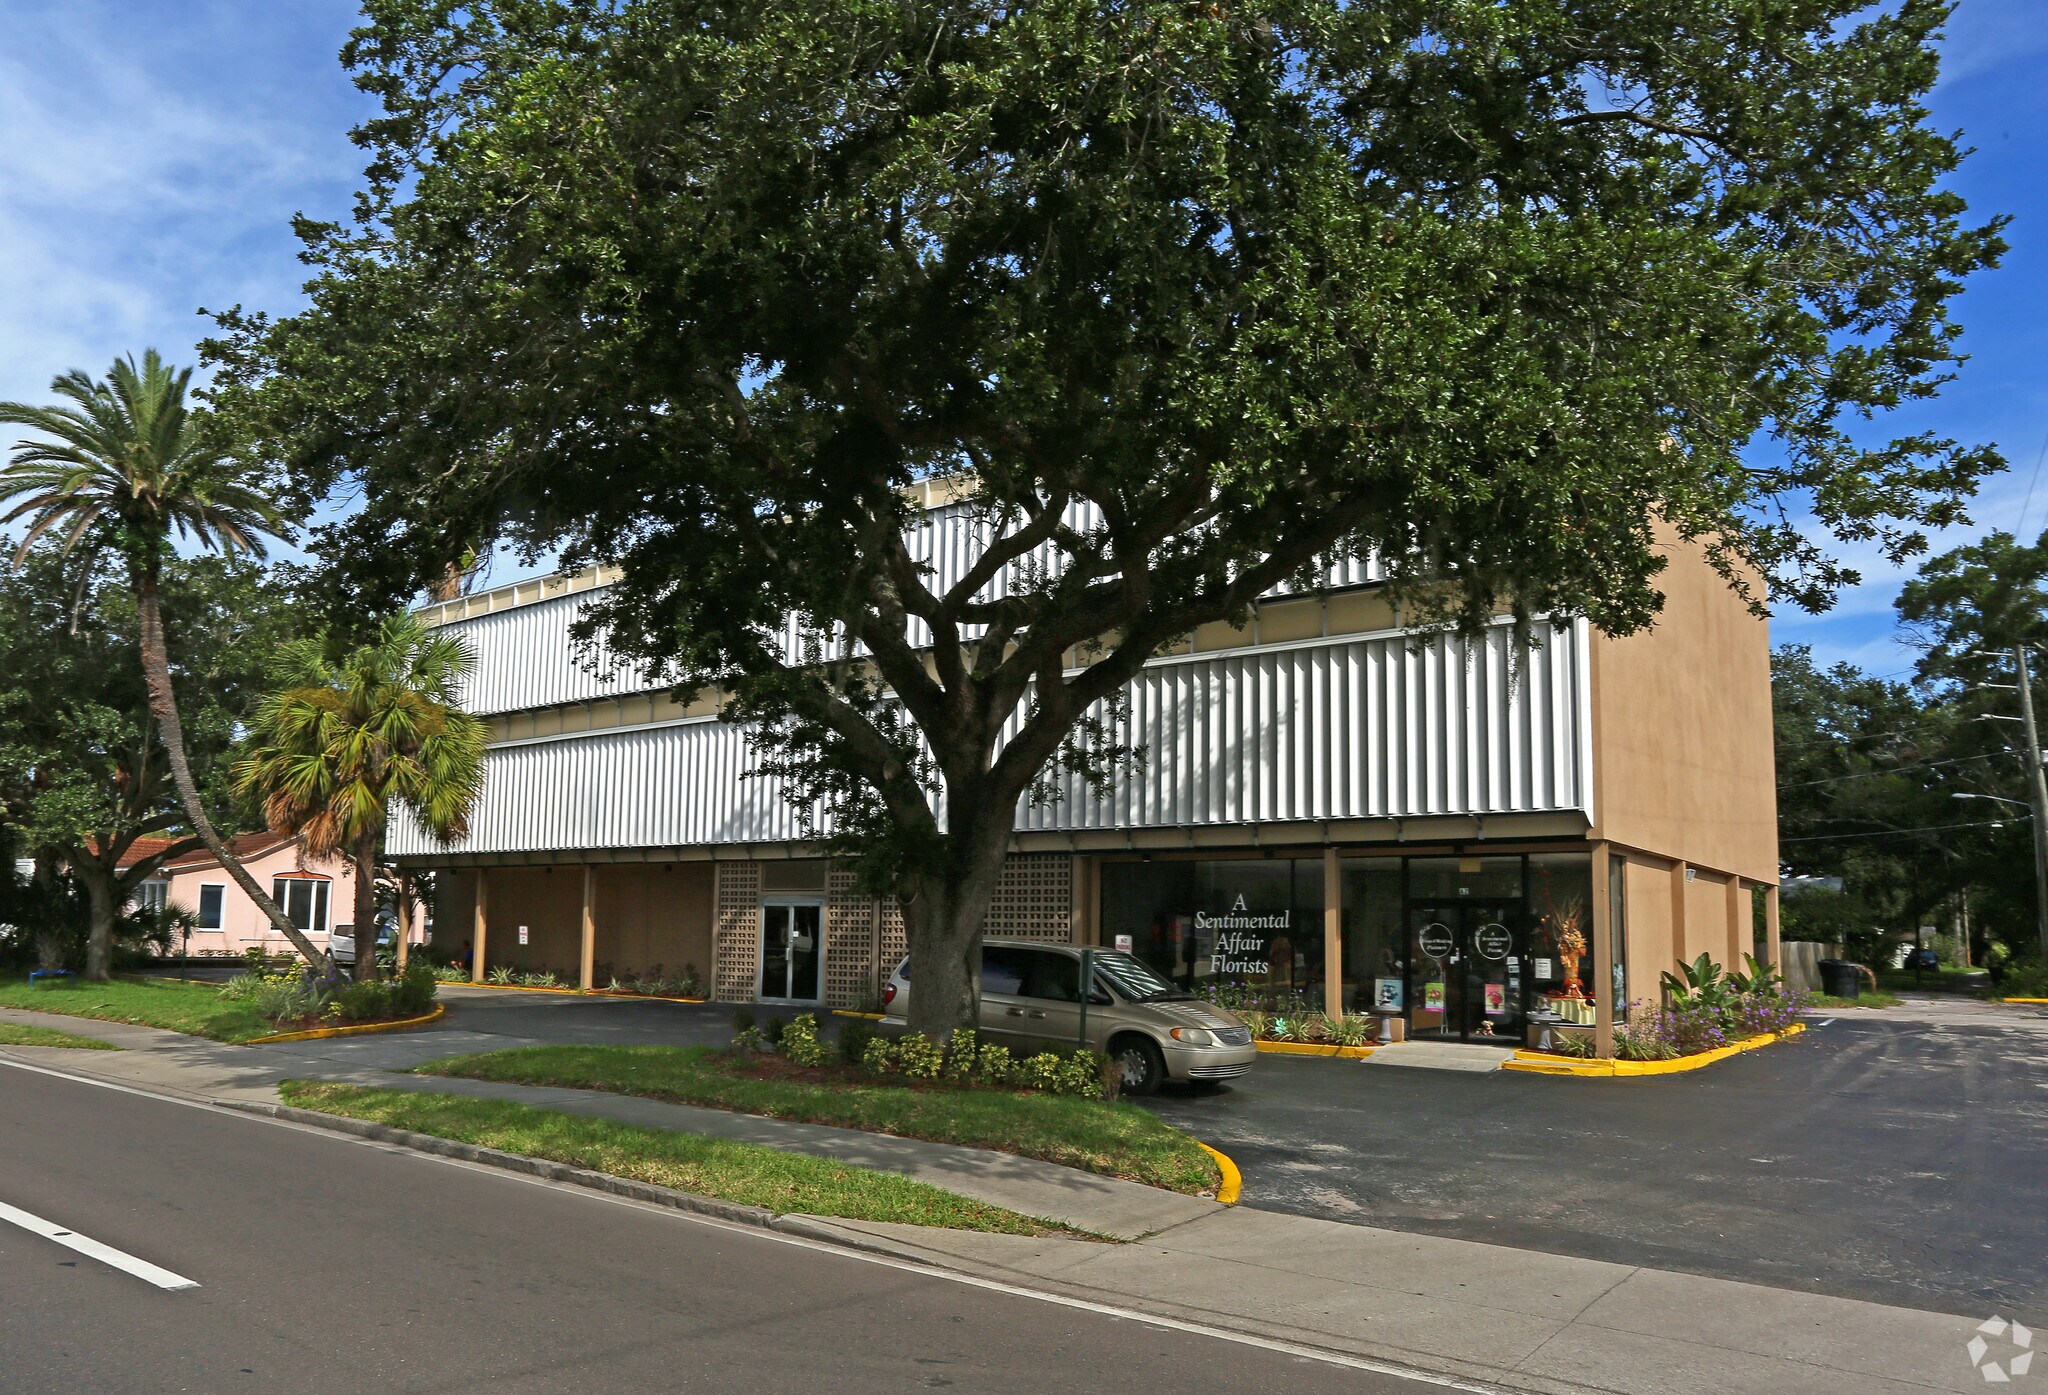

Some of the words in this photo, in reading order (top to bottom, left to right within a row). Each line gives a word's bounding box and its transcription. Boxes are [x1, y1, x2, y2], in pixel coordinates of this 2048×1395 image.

[1232, 893, 1248, 911] A
[1194, 909, 1290, 929] Sentimental
[1214, 931, 1264, 954] Affair
[1210, 954, 1269, 974] Florists
